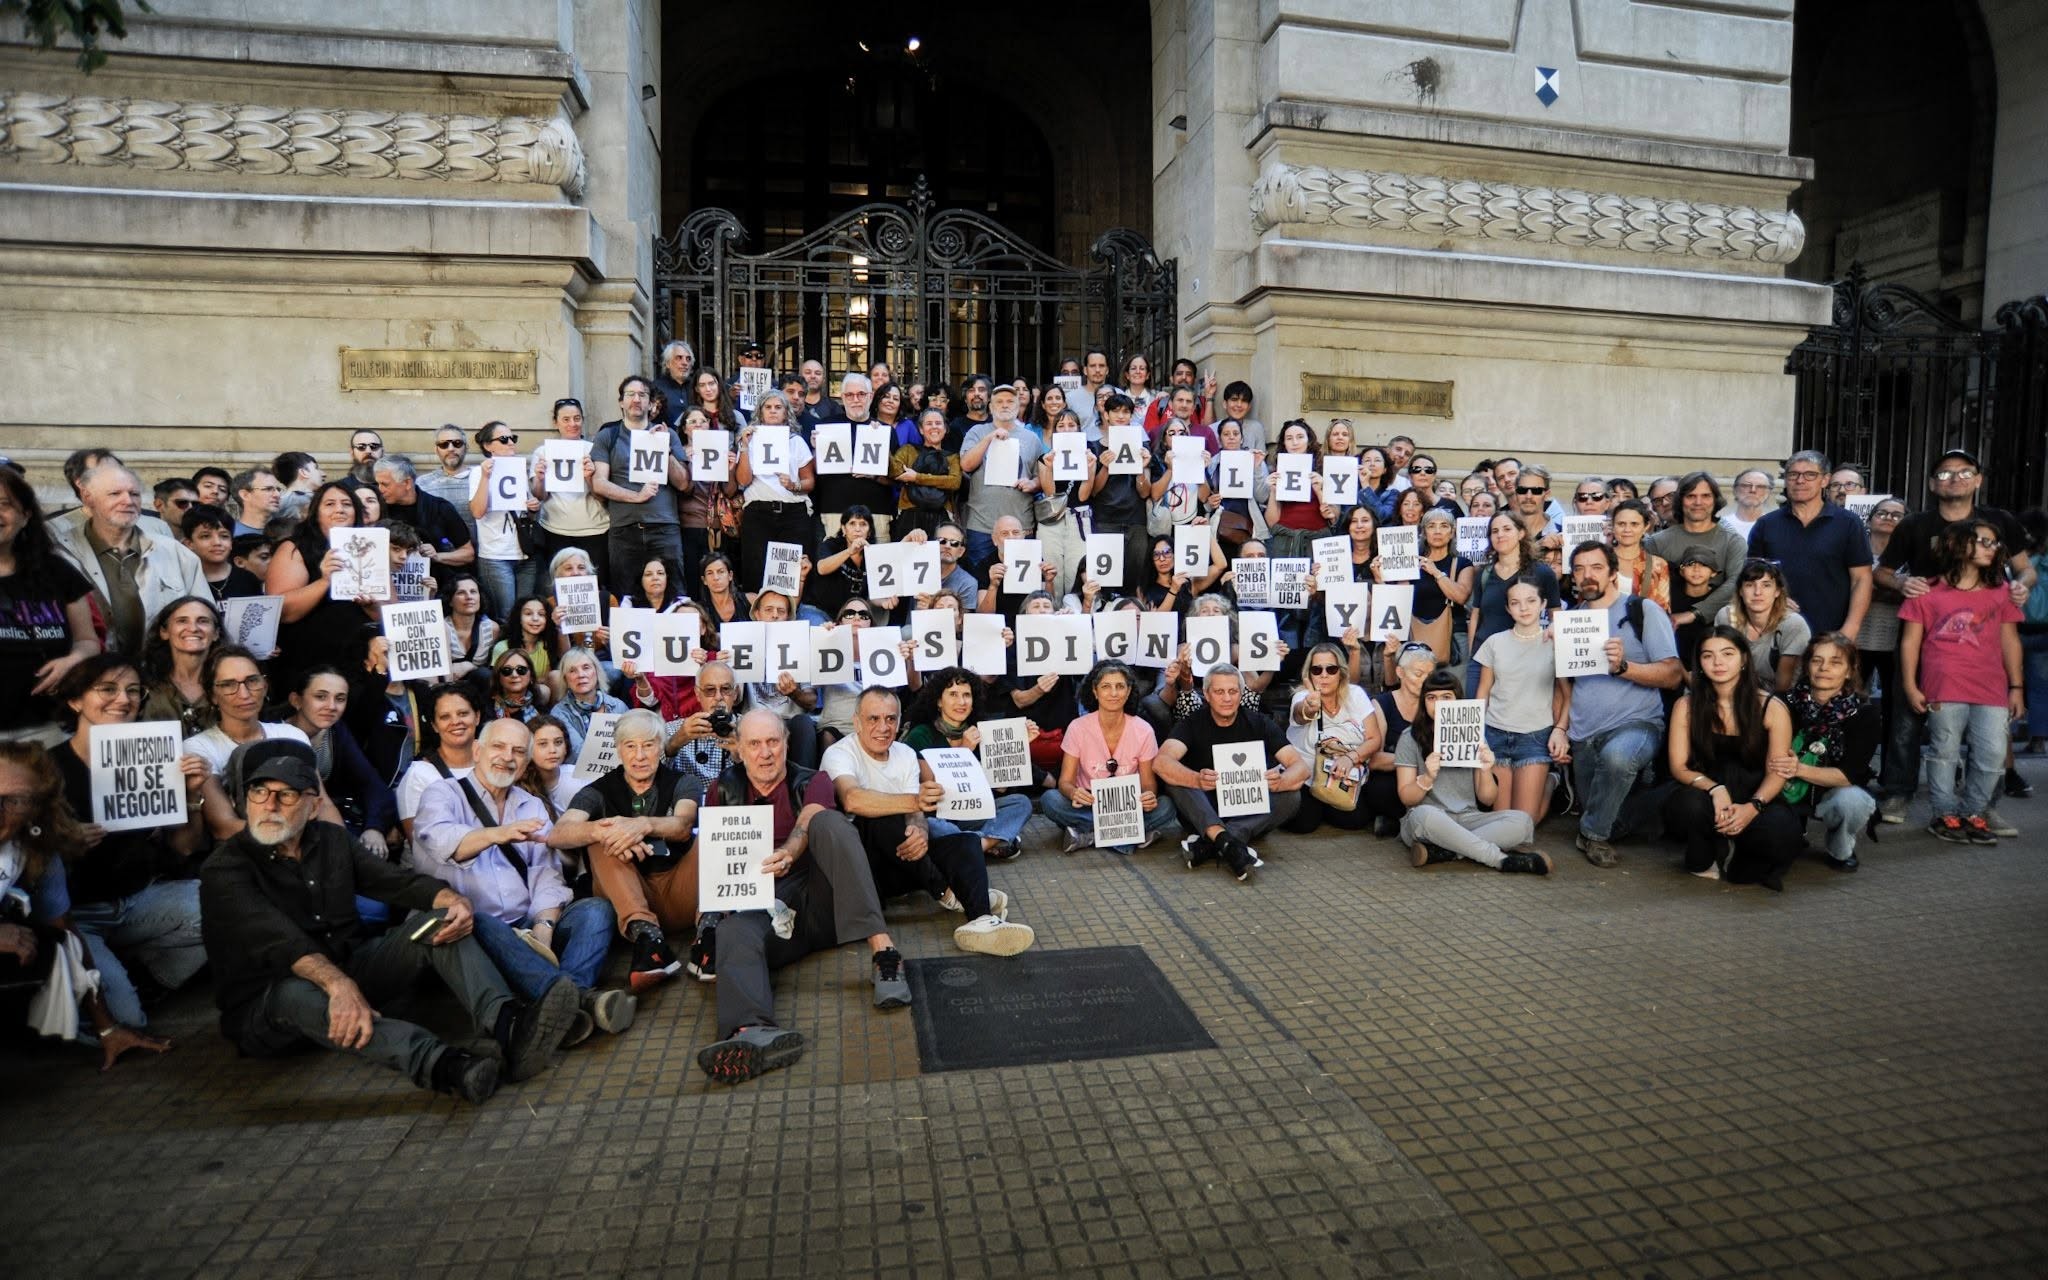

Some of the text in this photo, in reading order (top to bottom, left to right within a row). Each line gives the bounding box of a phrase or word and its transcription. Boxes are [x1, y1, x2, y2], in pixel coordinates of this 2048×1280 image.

[444, 361, 456, 378] DE
[459, 360, 497, 379] BUENOS
[500, 361, 529, 379] AIRES
[743, 371, 768, 385] SIN LEY
[747, 384, 755, 395] NO
[1381, 532, 1414, 545] APOYAMOS
[1471, 539, 1479, 550] ES
[771, 547, 800, 562] FAMILIAS
[1392, 545, 1405, 556] A LA
[777, 562, 788, 574] DEL
[1236, 562, 1266, 573] FAMILIAS
[1275, 562, 1306, 573] FAMILIAS
[1383, 555, 1415, 570] DOCENCIA
[767, 575, 796, 590] NACIONAL
[1237, 572, 1266, 583] CNBA
[1284, 573, 1297, 582] CON
[1324, 575, 1345, 583] 27.795
[404, 586, 412, 595] LA
[413, 585, 424, 595] LEY
[1237, 583, 1267, 593] POR LA LEY
[1275, 582, 1306, 592] DOCENTES
[568, 594, 574, 605] DE
[580, 593, 589, 603] LEY
[1278, 591, 1301, 605] UBA
[391, 609, 437, 627] FAMILIAS
[407, 625, 426, 639] CON
[1563, 626, 1600, 634] APLICACIÓN
[395, 637, 440, 653] DOCENTES
[1575, 648, 1589, 657] LEY
[397, 649, 442, 672] CNBA
[1568, 659, 1597, 670] 27.795
[1440, 706, 1481, 725] SALARIOS
[992, 727, 1014, 743] QUE NO
[1440, 725, 1480, 744] DIGNOS
[101, 735, 175, 768] LA UNIVERSIDAD
[985, 740, 1025, 757] DESAPAREZCA
[1440, 744, 1480, 761] ES LEY
[597, 752, 614, 761] LEY
[986, 754, 1027, 769] LA UNIVERSIDAD
[114, 765, 164, 793] NO SE
[1220, 767, 1262, 785] EDUCACIÓN
[957, 782, 972, 793] LEY
[1096, 784, 1137, 815] FAMILIAS
[1222, 786, 1263, 806] PÚBLICA
[103, 788, 178, 821] NEGOCIA
[950, 798, 982, 810] 27.795
[722, 816, 751, 826] POR LA
[1098, 812, 1138, 828] MOVILIZADAS POR LA
[711, 830, 762, 841] APLICACIÓN
[1099, 826, 1123, 841] UNIVERSIDAD
[726, 846, 748, 856] DE LA
[727, 862, 747, 876] LEY
[717, 883, 757, 897] 27.795
